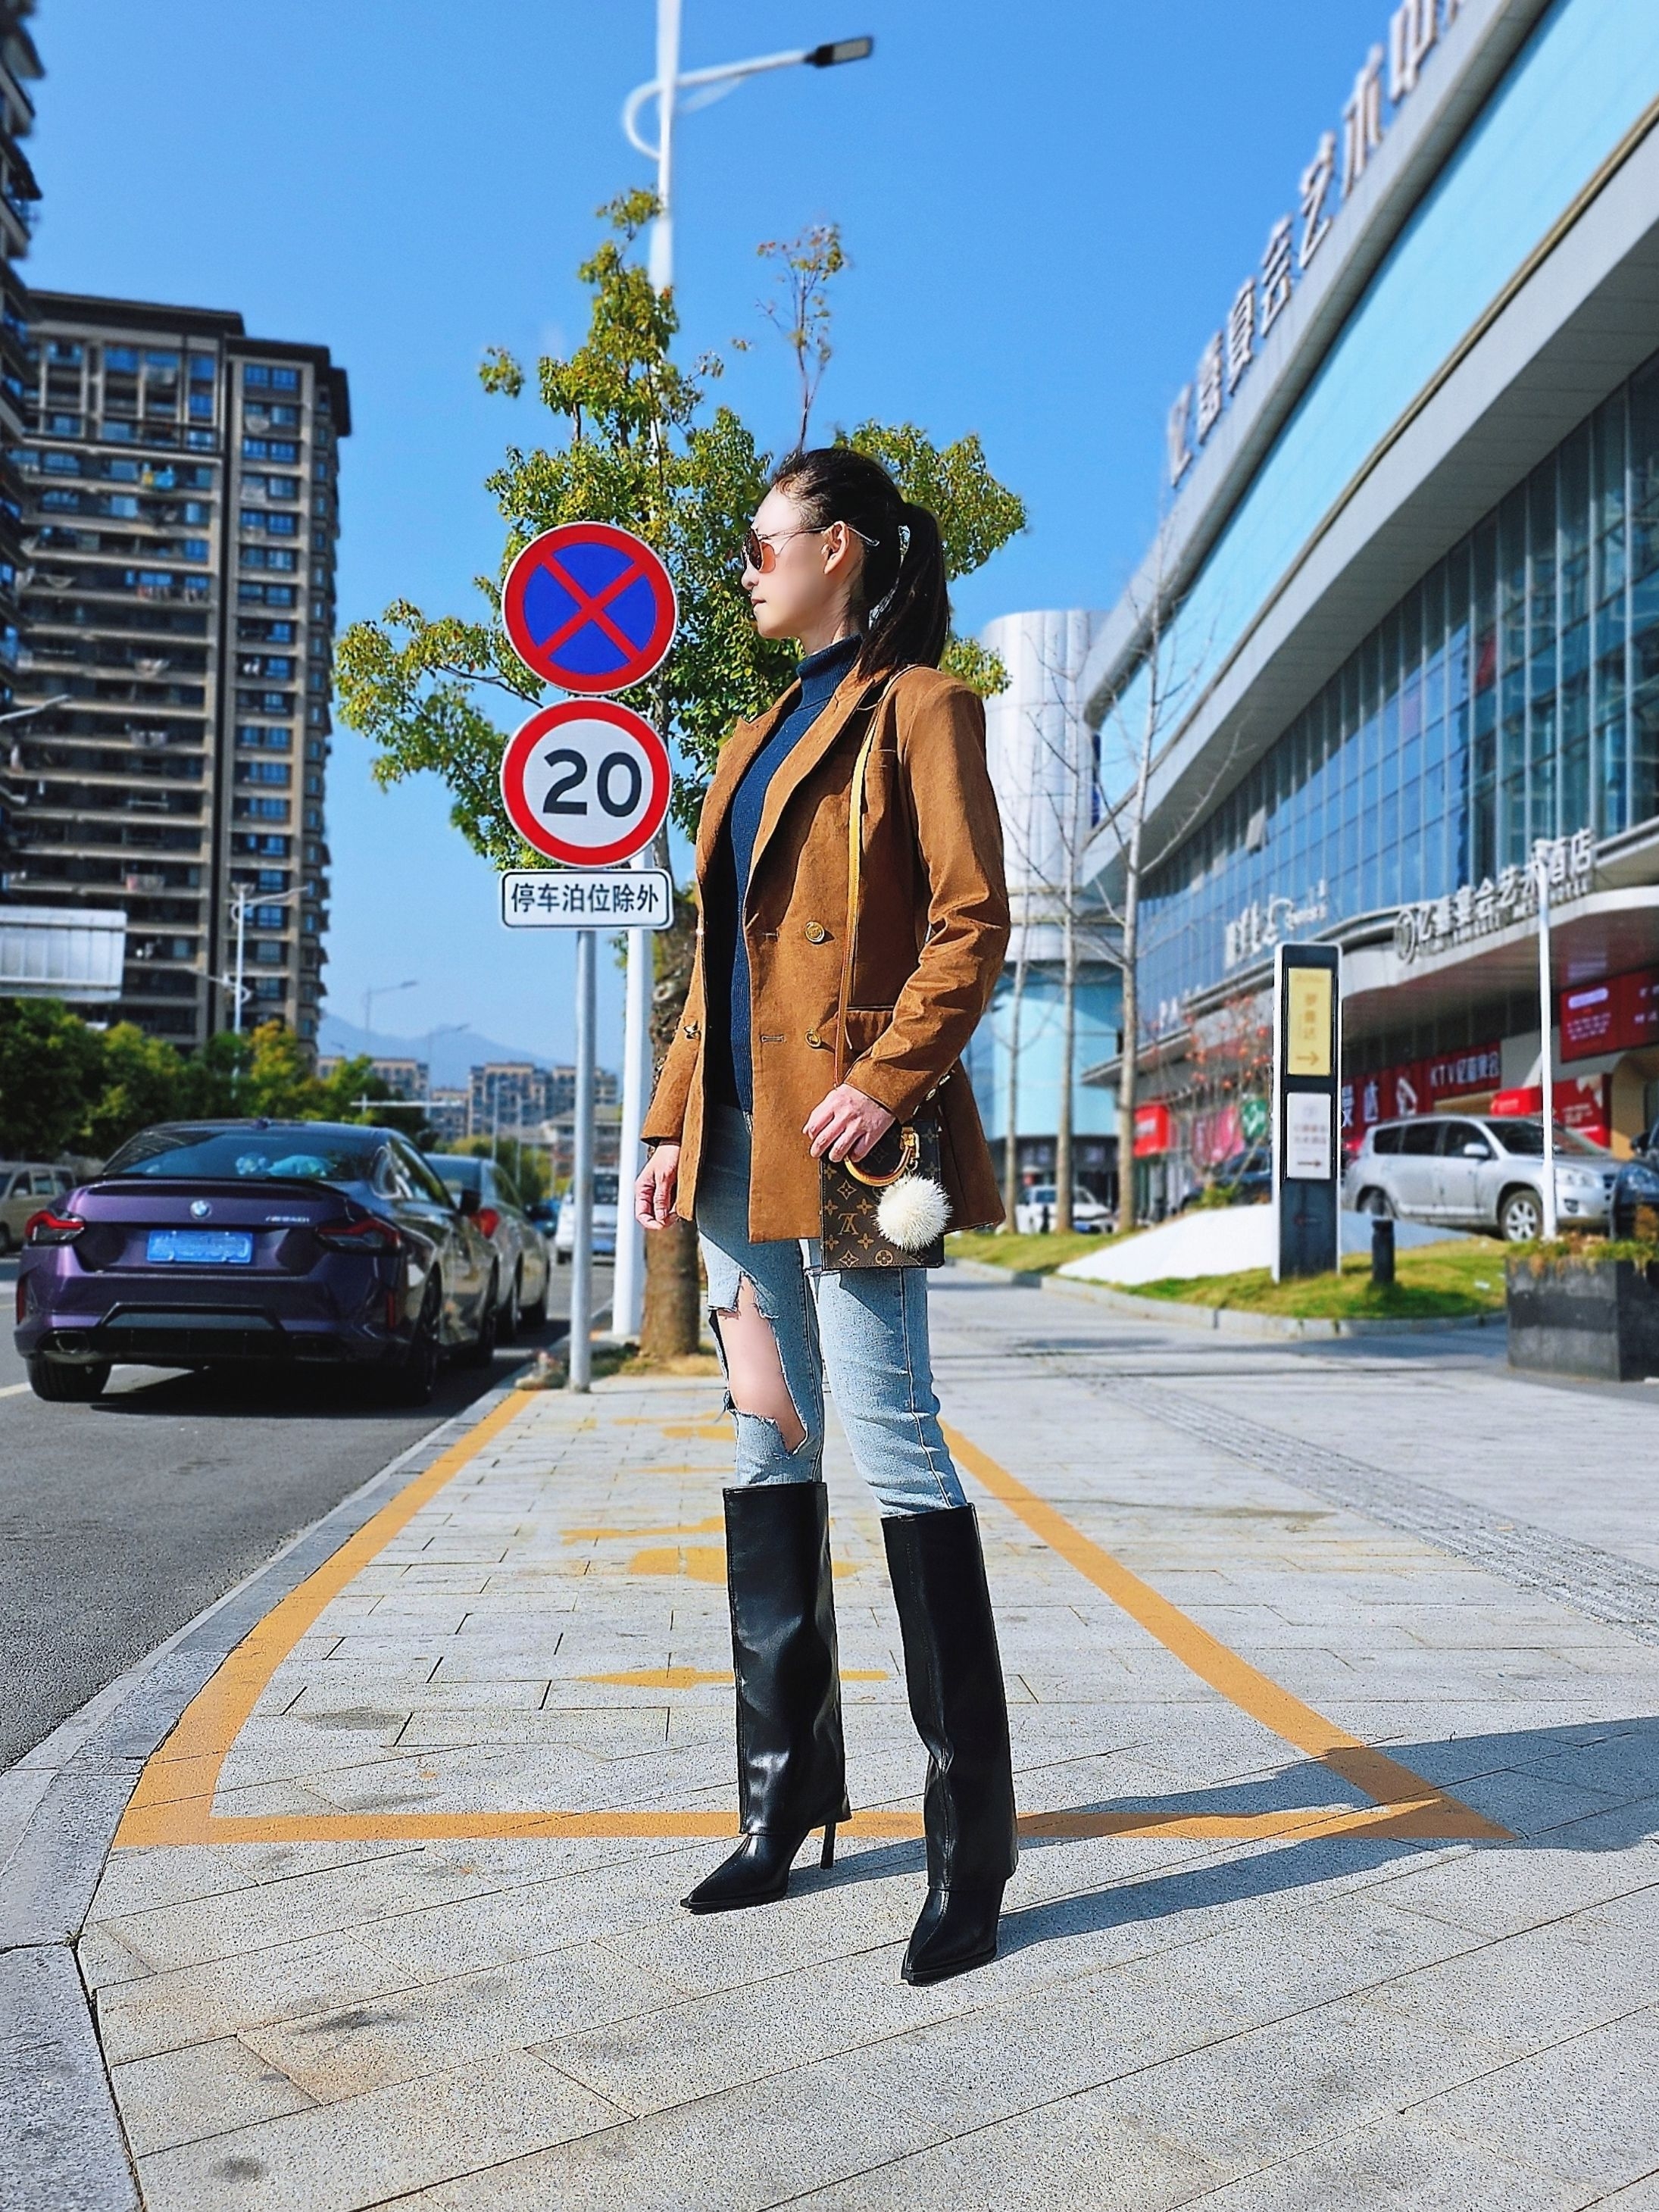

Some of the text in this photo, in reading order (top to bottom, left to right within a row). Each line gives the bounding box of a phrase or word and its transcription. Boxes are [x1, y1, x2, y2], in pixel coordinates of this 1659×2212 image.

[542, 748, 642, 818] 20
[511, 882, 659, 914] 停车泊位除外
